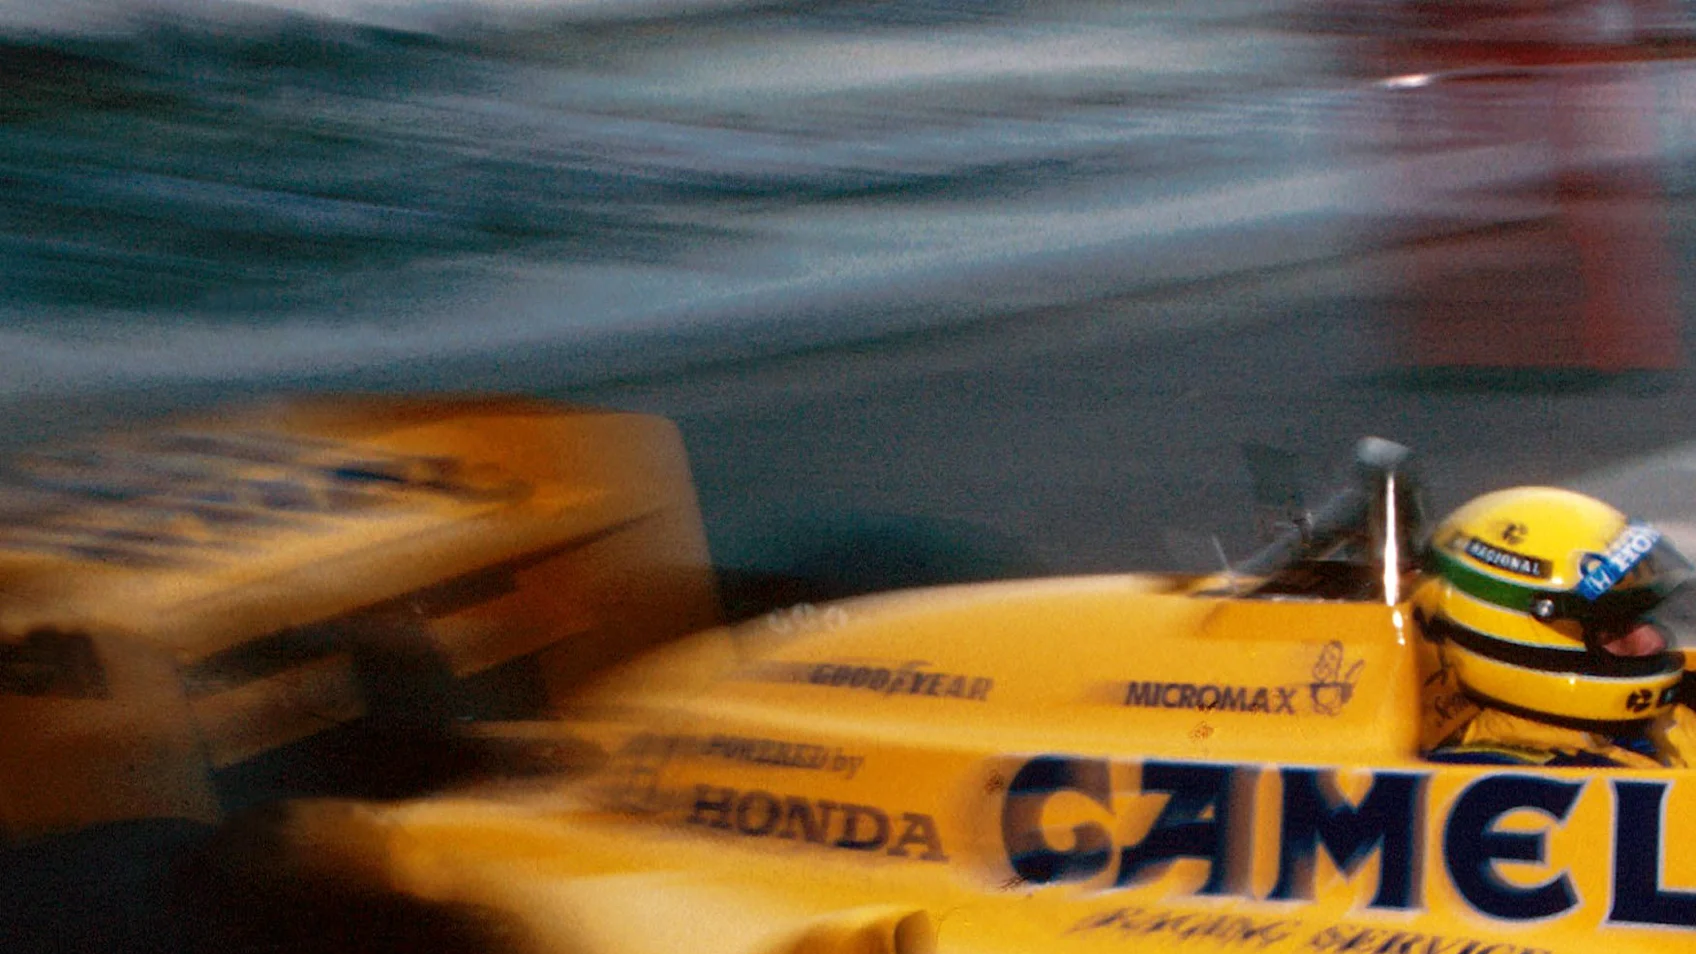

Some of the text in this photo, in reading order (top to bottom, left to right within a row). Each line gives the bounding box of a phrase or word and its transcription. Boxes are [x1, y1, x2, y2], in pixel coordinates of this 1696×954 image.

[1122, 681, 1298, 716] MICROMAX
[832, 747, 865, 780] by
[686, 783, 950, 863] HONDA
[1062, 903, 1298, 950] RACING
